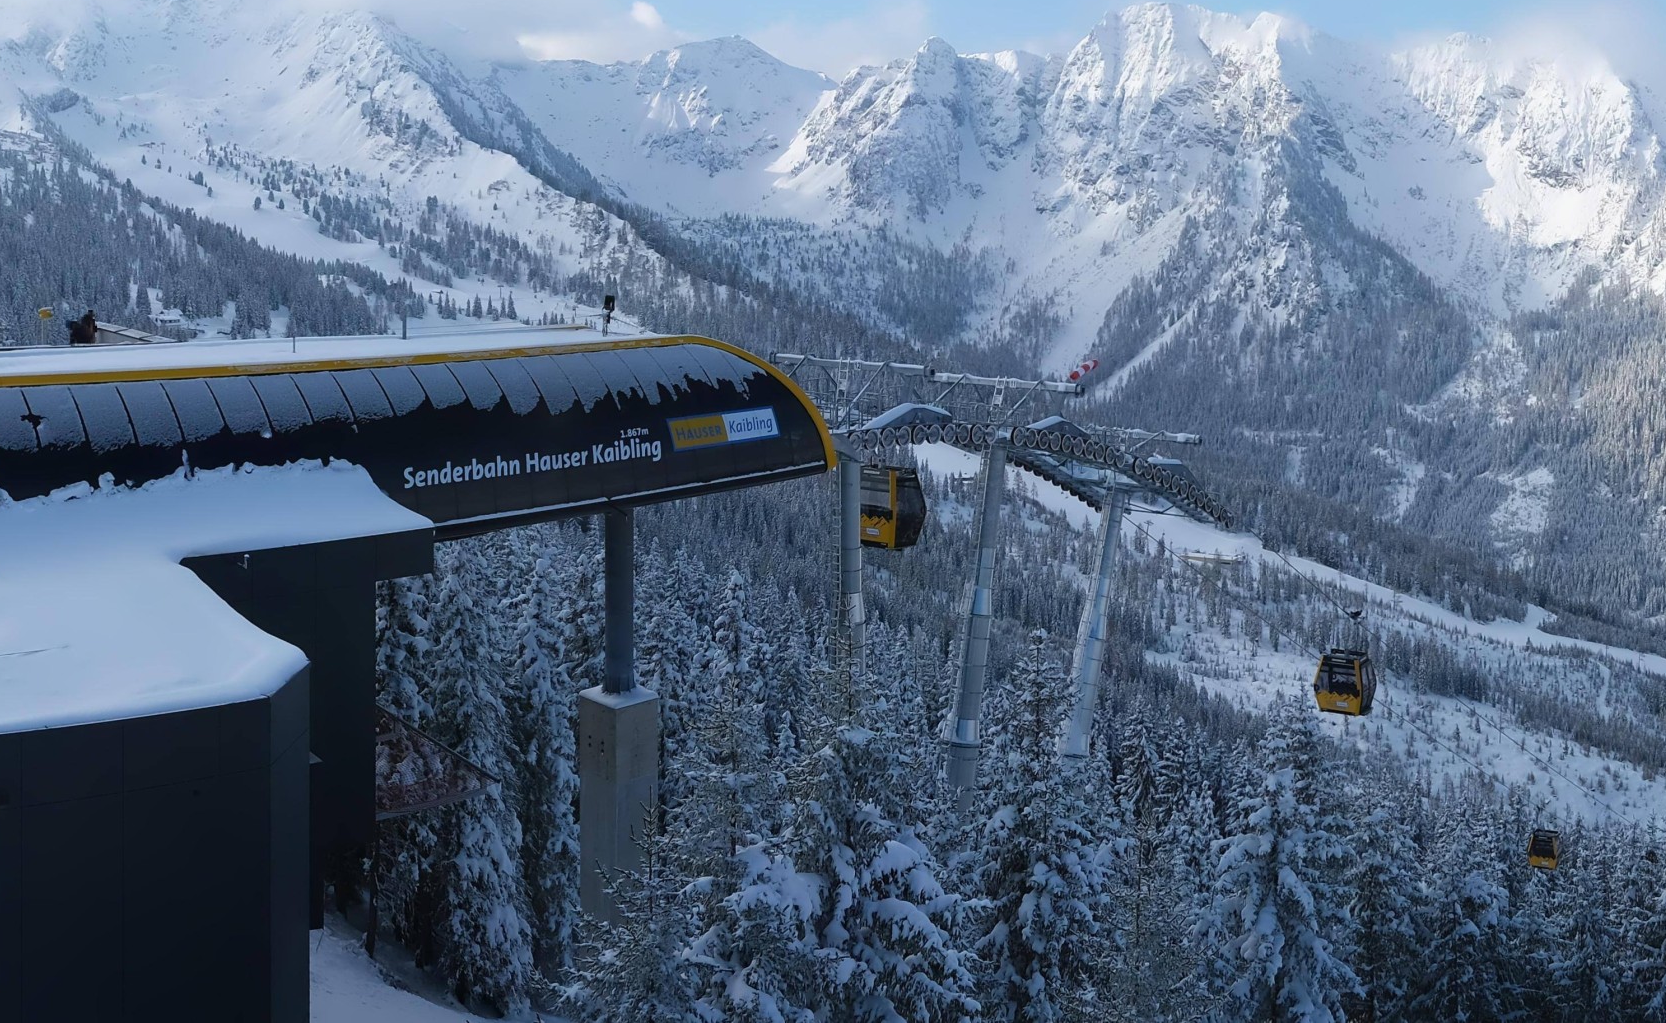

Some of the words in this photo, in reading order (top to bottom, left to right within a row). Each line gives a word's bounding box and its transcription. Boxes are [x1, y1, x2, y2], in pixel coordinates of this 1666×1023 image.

[620, 427, 649, 438] 1.867m
[675, 424, 722, 441] HAUSER
[728, 416, 773, 434] Kaibling
[403, 455, 520, 489] Senderbahn
[526, 450, 588, 473] Hauser
[592, 438, 662, 464] Kaibling
